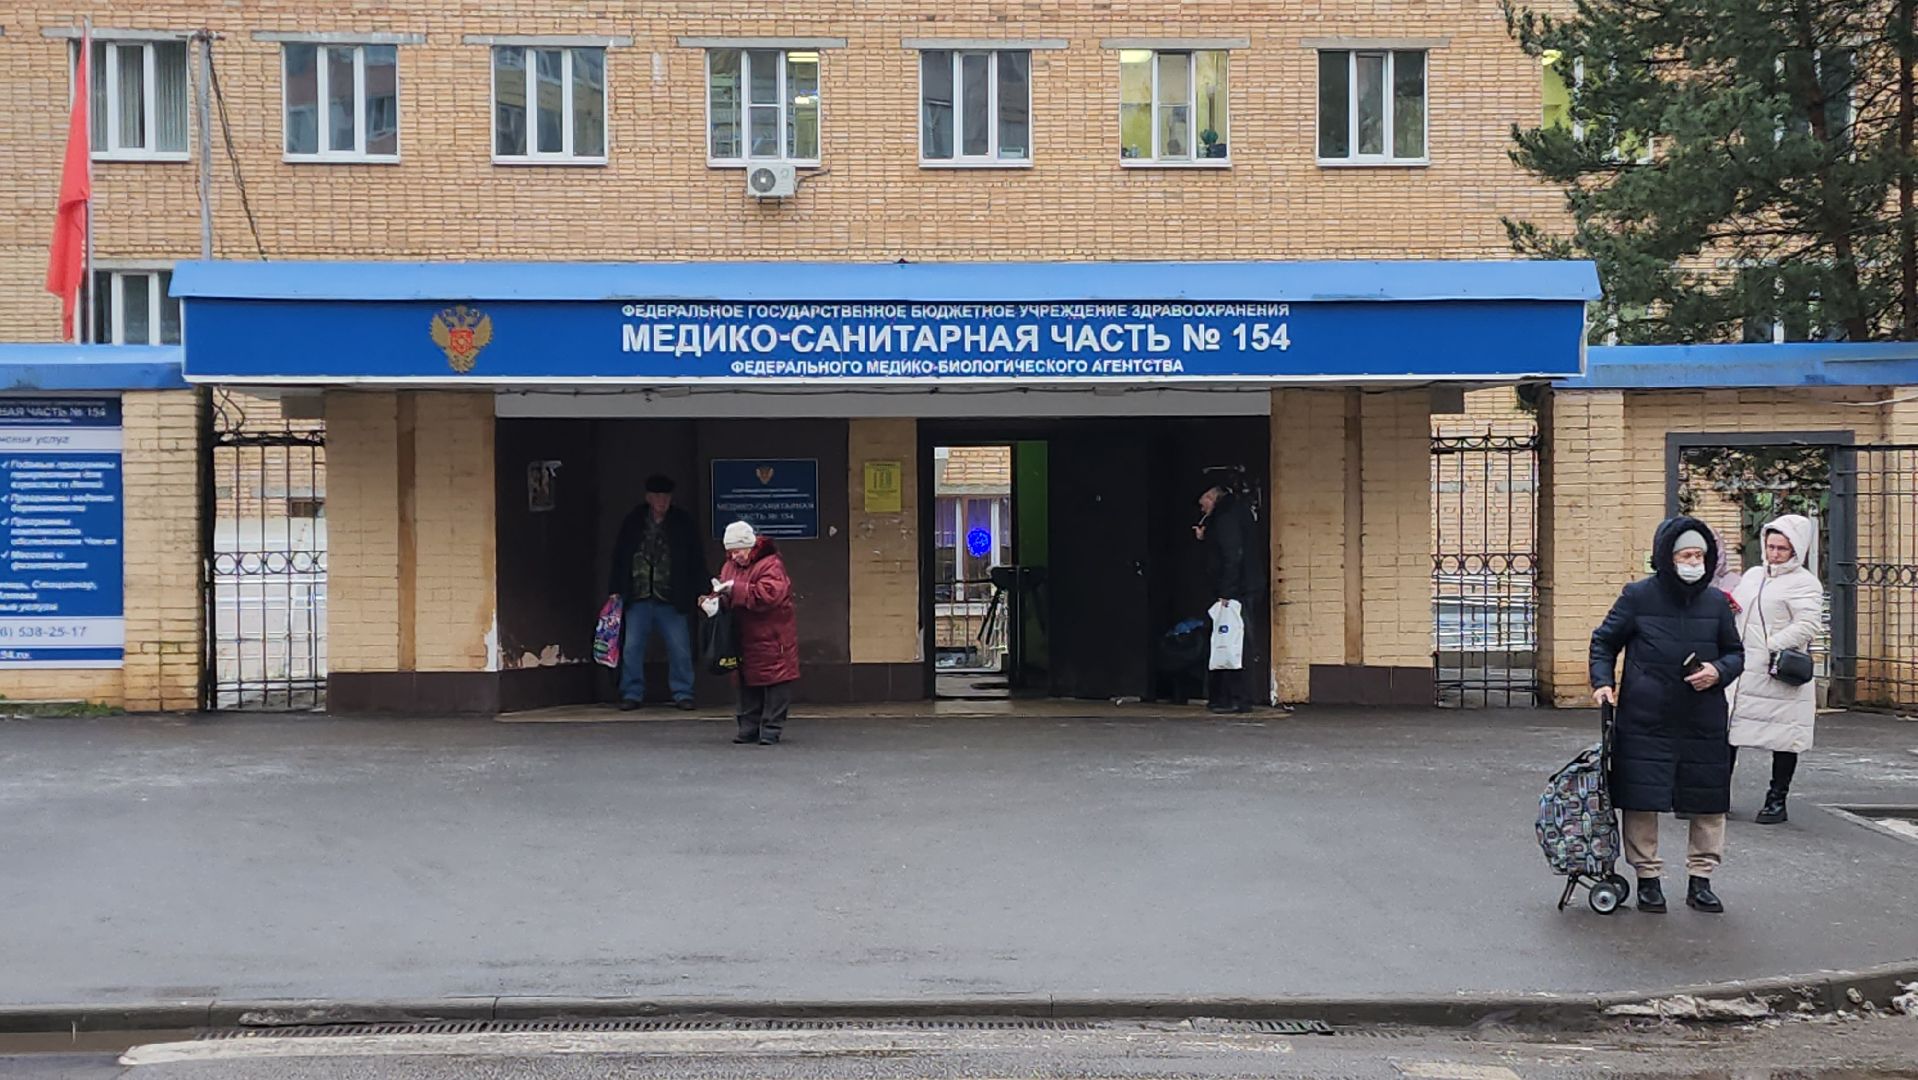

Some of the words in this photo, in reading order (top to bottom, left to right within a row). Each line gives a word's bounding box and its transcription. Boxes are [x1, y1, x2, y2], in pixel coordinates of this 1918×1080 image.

[621, 304, 744, 319] ФЕДЕРАЛЬНОЕ
[748, 304, 907, 320] ГОСУДАРСТВЕННОЕ
[911, 304, 1015, 319] БЮДЖЕТНОЕ
[1020, 304, 1127, 319] УЧРЕЖДЕНИЕ
[1131, 303, 1290, 318] ЗДРАВООХРАНЕНИЯ
[622, 323, 1039, 357] МЕДИКО-САНИТАРНАЯ
[1051, 323, 1171, 352] ЧАСТЬ
[1183, 323, 1221, 352] №
[1232, 323, 1291, 351] 154
[731, 359, 862, 374] ФЕДЕРАЛЬНОГО
[866, 358, 1088, 374] МЕДИКО-БИОЛОГИЧЕСКОГО
[1092, 358, 1184, 373] АГЕНТСТВА
[26, 407, 68, 417] ЧАСТЬ
